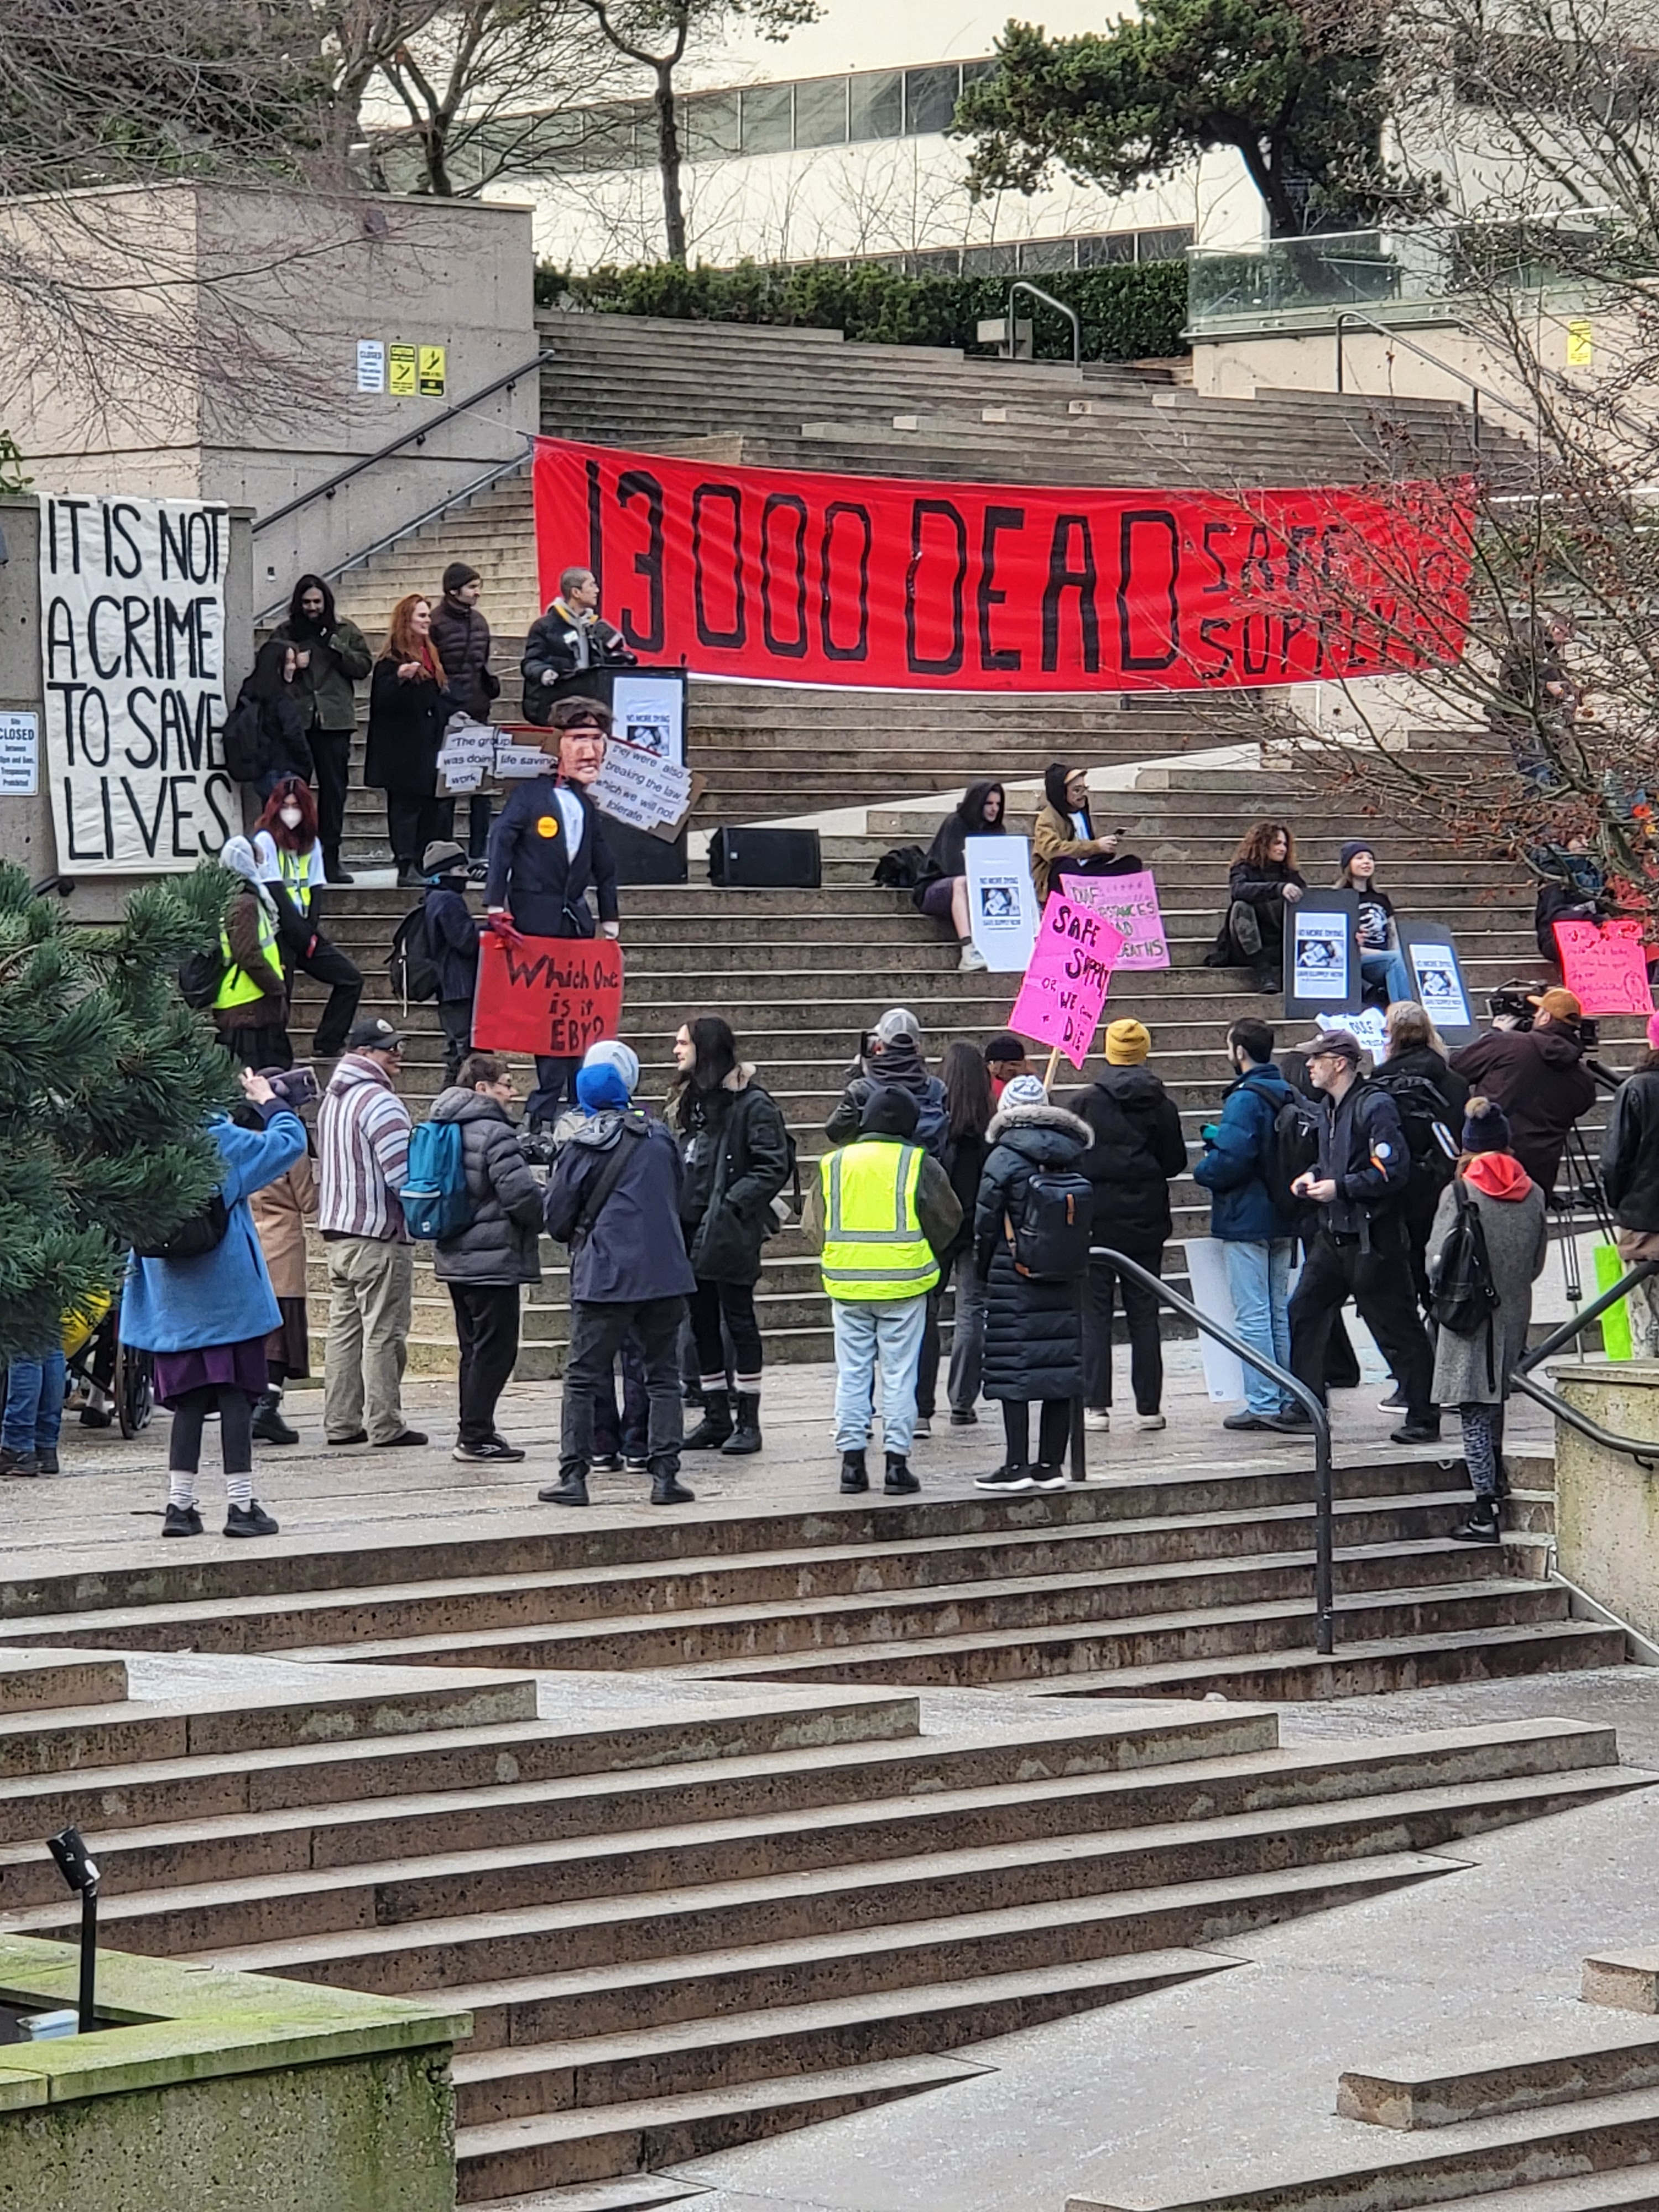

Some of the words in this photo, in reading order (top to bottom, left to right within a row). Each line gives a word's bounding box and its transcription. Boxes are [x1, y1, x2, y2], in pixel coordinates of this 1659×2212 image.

[48, 499, 90, 575] IT
[102, 503, 143, 579] IS
[158, 506, 228, 585] NOT
[905, 498, 1179, 675] DEAD
[48, 596, 78, 680] A
[87, 594, 217, 680] CRIME
[46, 681, 110, 768] TO
[124, 686, 229, 771] SAVE
[444, 757, 464, 765] was
[467, 753, 495, 764] doin
[500, 754, 517, 765] life
[605, 760, 646, 785] breaking
[645, 778, 662, 793] the
[632, 752, 658, 768] were
[662, 764, 685, 779] also
[64, 772, 232, 860] LIVES
[595, 779, 623, 796] which
[623, 791, 638, 802] we
[640, 799, 658, 811] will
[656, 806, 675, 820] not
[1052, 905, 1101, 948] SAFE
[505, 946, 589, 989] Which
[1041, 977, 1057, 992] OR
[548, 992, 572, 1018] is
[580, 998, 595, 1017] it
[1060, 991, 1078, 1010] WE
[550, 1015, 605, 1052] EBY?
